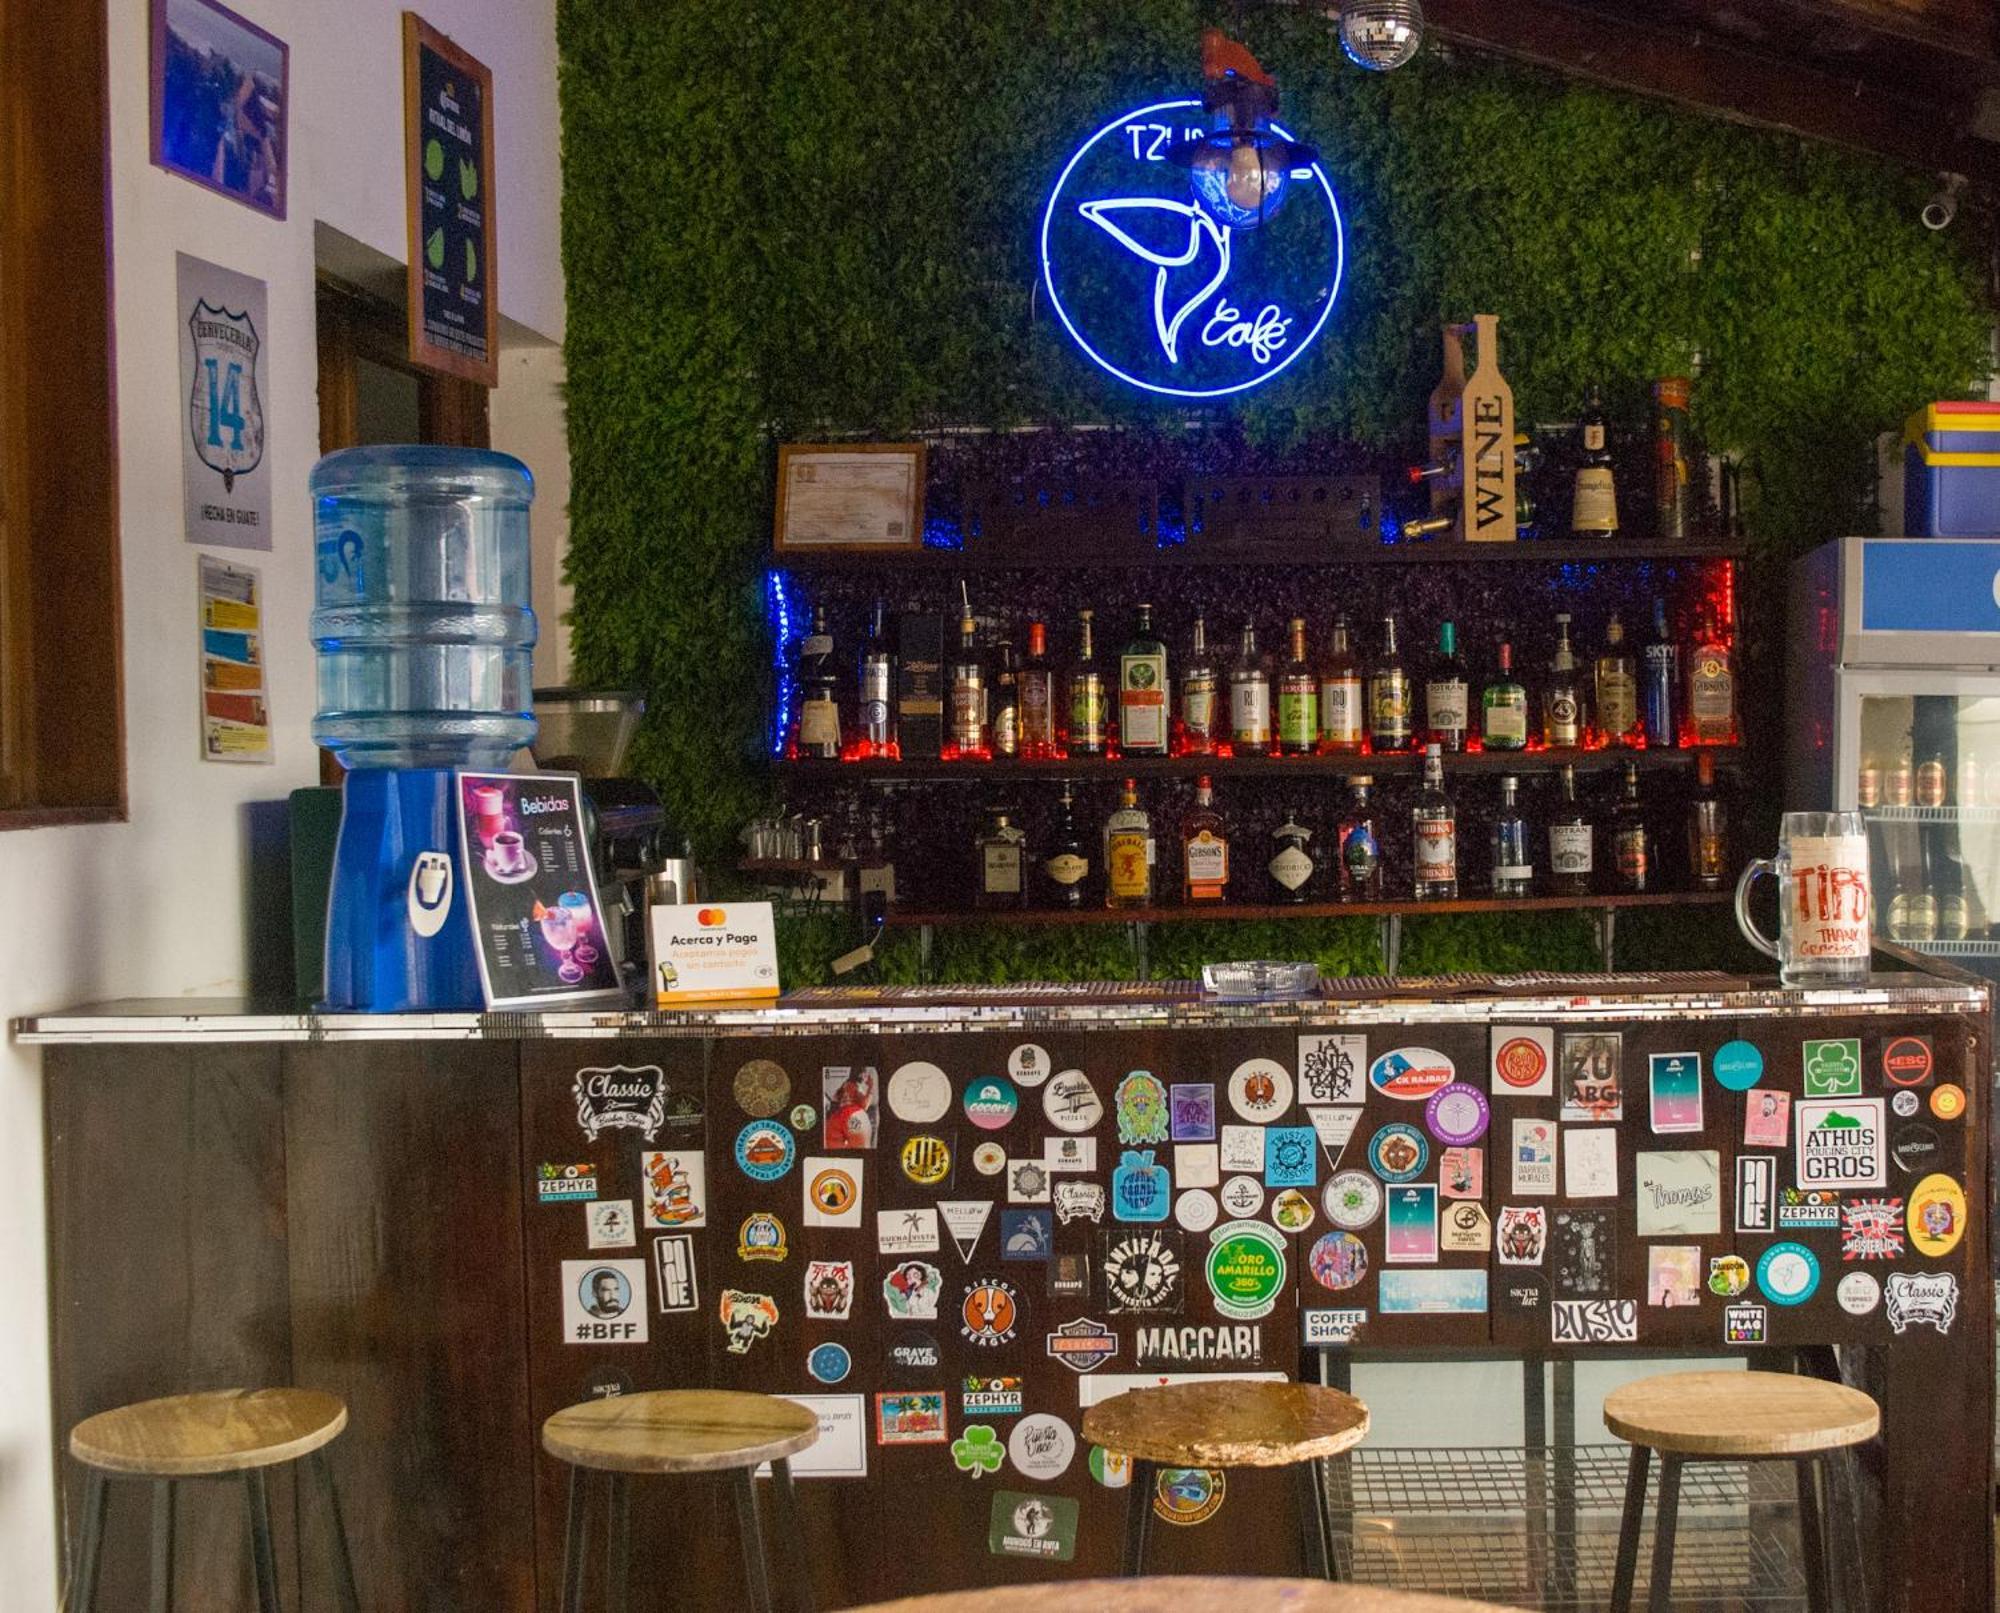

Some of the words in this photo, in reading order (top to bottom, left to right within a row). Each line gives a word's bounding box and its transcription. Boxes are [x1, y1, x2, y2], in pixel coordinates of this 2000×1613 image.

[1201, 297, 1293, 364] Café
[204, 357, 246, 451] 14
[1474, 395, 1505, 532] WINE
[1645, 644, 1675, 658] SKYY
[521, 797, 569, 816] Bebidas
[670, 936, 714, 946] Acerca
[716, 937, 724, 947] y
[726, 933, 758, 945] Paga
[587, 1075, 653, 1097] Classic
[1806, 1128, 1874, 1147] ATHUS
[1806, 1156, 1875, 1179] GROS
[541, 1180, 594, 1192] ZEPHYR
[1782, 1206, 1836, 1219] ZEPHYR
[880, 1234, 907, 1243] BUENA
[911, 1233, 936, 1241] VISTA
[1216, 1265, 1276, 1275] AMARILLO
[963, 1277, 1017, 1299] DISCOS
[1896, 1281, 1945, 1299] Classic
[1309, 1313, 1362, 1325] COFFEE
[1728, 1309, 1764, 1320] WHITE
[575, 1322, 637, 1339] #BFF
[1729, 1319, 1762, 1330] FLAG
[960, 1327, 1017, 1347] BEAGLE
[1728, 1329, 1762, 1341] TOYS
[1136, 1325, 1261, 1362] MACCABI
[893, 1348, 934, 1358] GRAVE
[906, 1357, 938, 1367] YARD
[966, 1394, 1020, 1405] ZEPHYR
